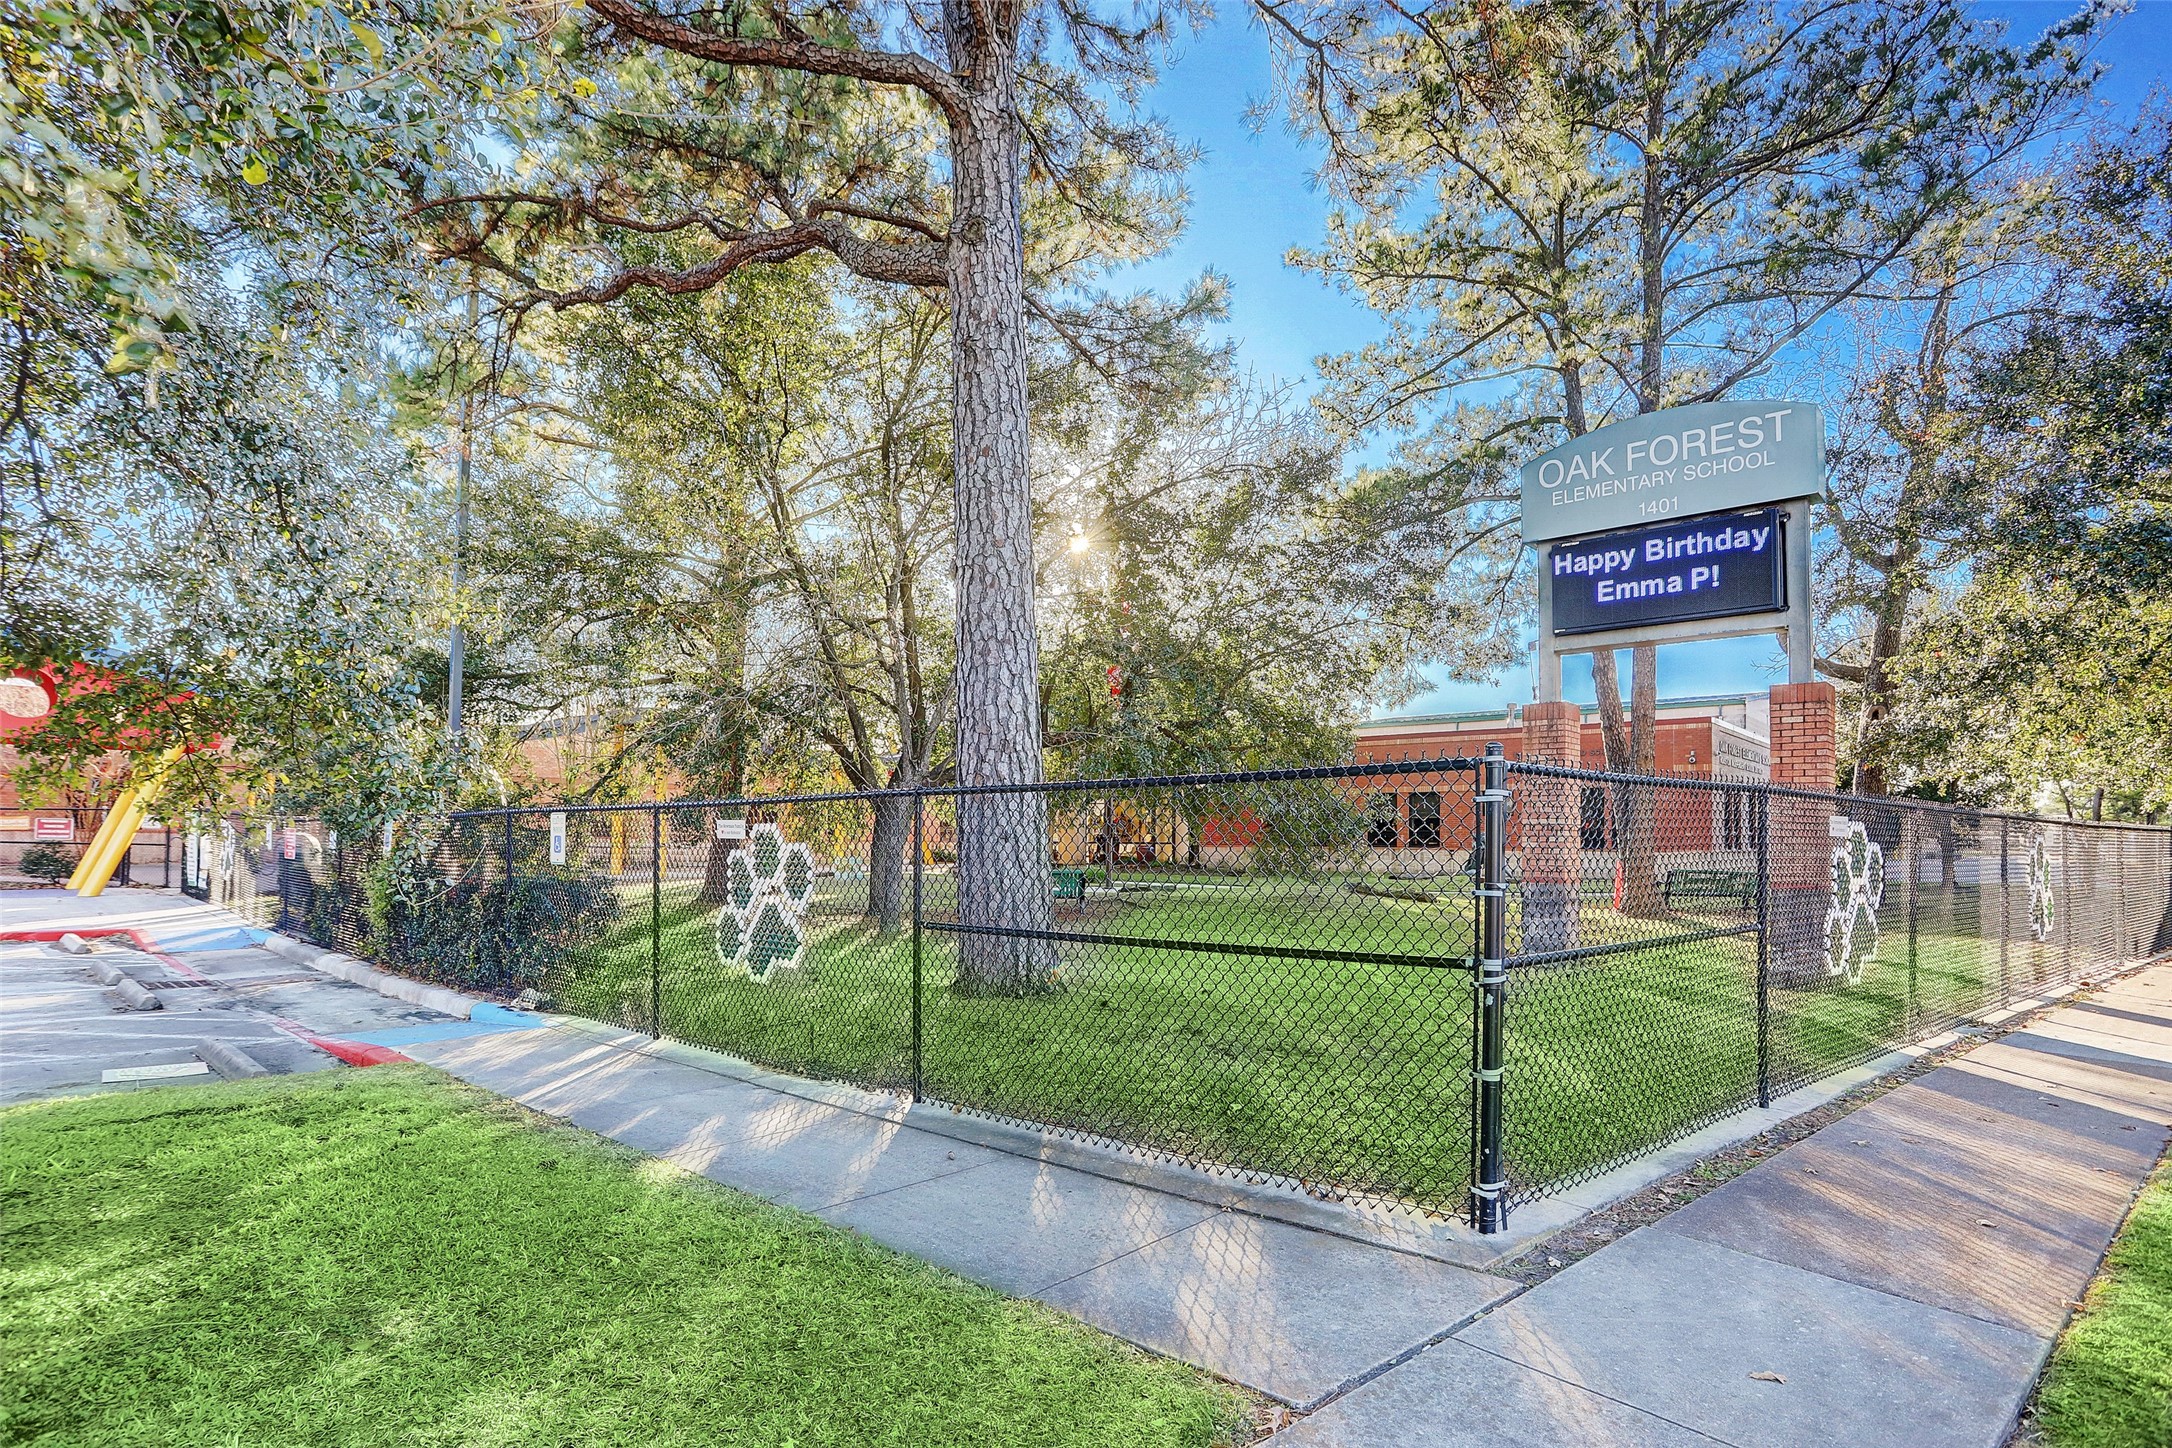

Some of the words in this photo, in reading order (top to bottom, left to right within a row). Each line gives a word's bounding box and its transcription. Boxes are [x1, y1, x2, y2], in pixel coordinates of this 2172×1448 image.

[1538, 446, 1616, 489] OAK
[1626, 408, 1793, 472] FOREST
[1552, 467, 1678, 507] ELEMENTARY
[1683, 450, 1776, 482] SCHOOL
[1638, 496, 1679, 517] 1401
[1553, 546, 1636, 576] Happy
[1644, 525, 1771, 563] Birthday
[1597, 574, 1684, 603] Emma
[1690, 564, 1721, 591] P!
